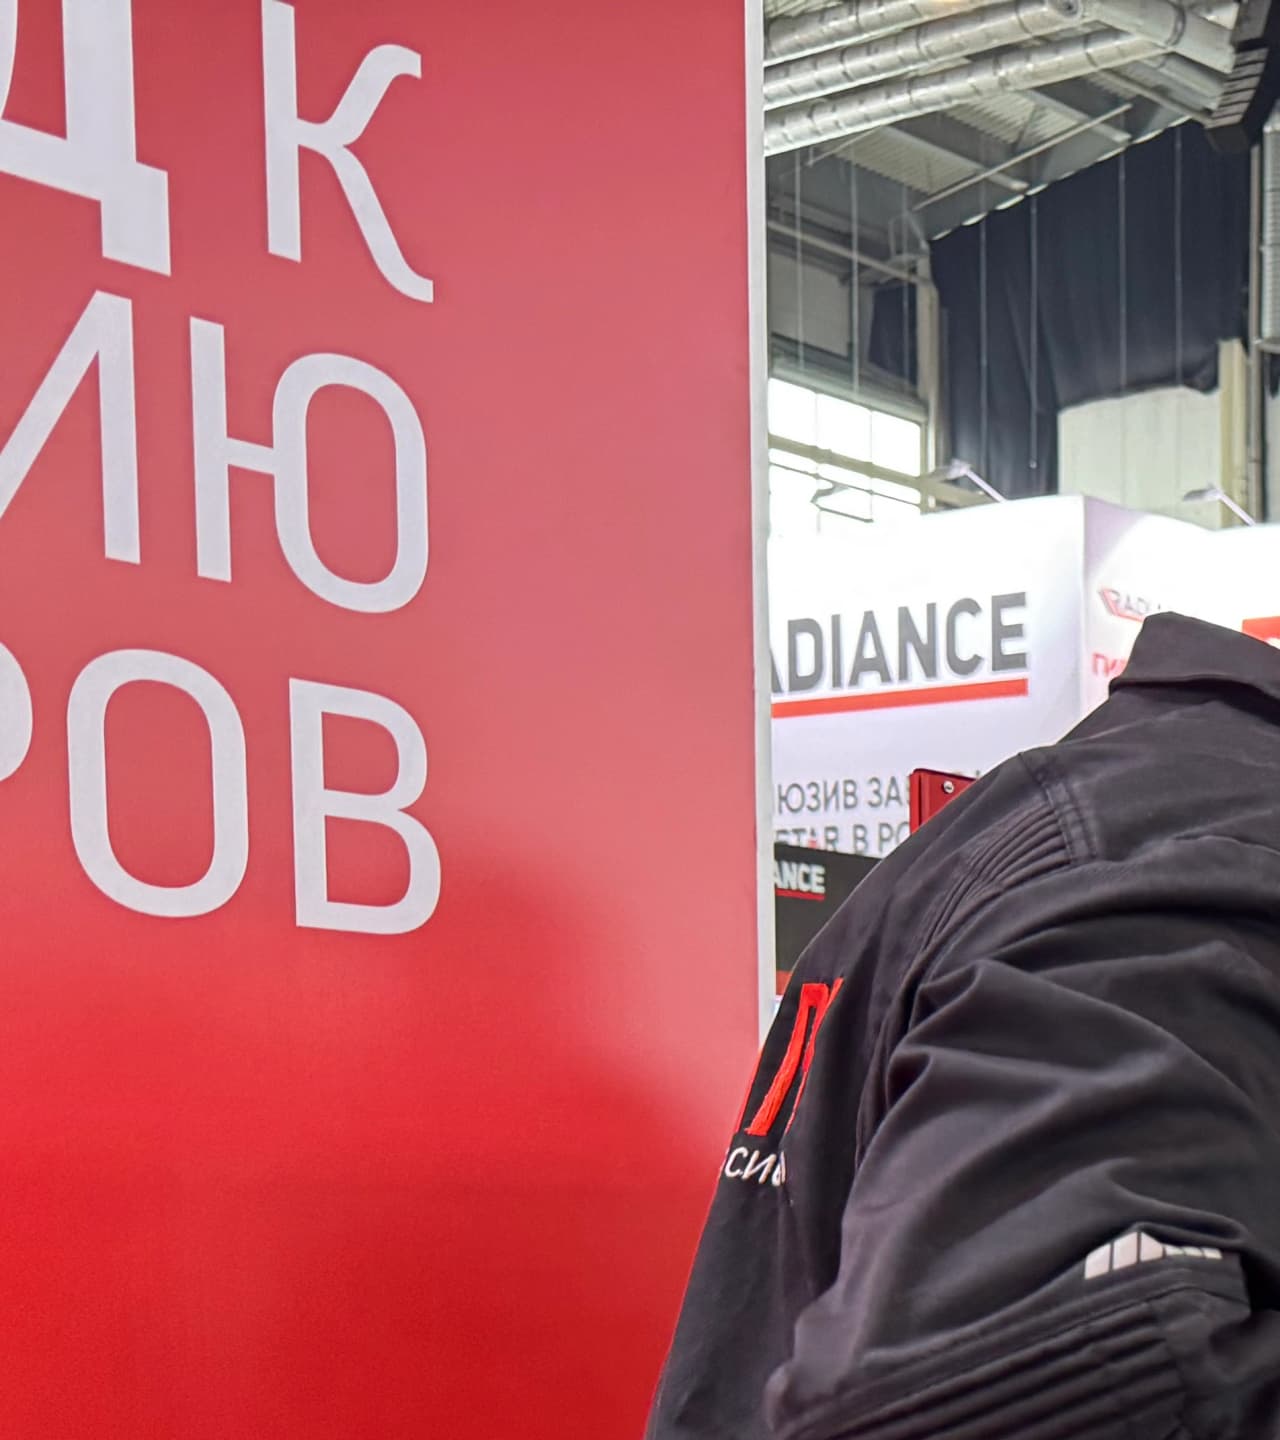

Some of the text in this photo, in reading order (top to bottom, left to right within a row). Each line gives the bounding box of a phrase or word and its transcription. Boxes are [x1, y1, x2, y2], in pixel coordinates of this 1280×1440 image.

[261, 0, 434, 303] К
[0, 640, 442, 935] ОВ
[867, 776, 910, 808] ЗА
